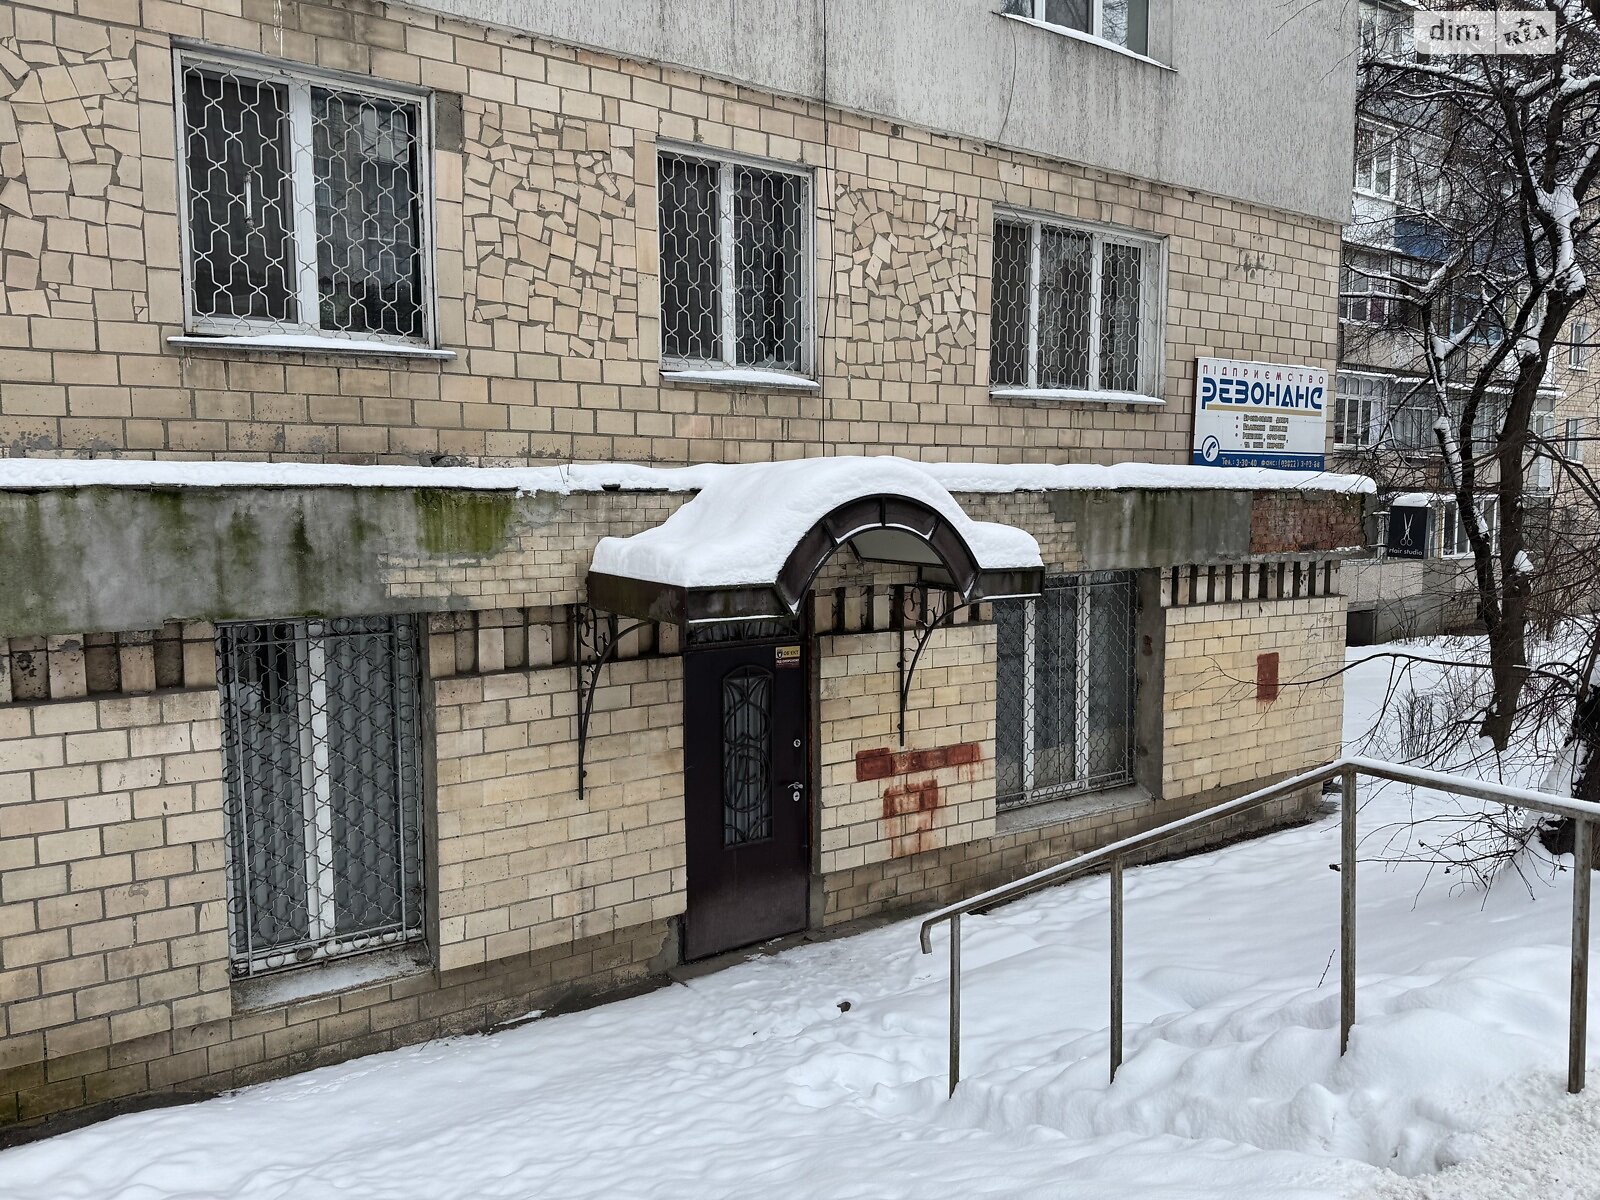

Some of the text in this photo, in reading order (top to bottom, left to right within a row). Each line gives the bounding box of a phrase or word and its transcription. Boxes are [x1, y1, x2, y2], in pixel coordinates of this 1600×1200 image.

[1203, 365, 1324, 384] ПІДПРИЄМСТВО
[1201, 376, 1323, 410] РЕЗОНАНС
[1236, 458, 1258, 467] 3-30-40
